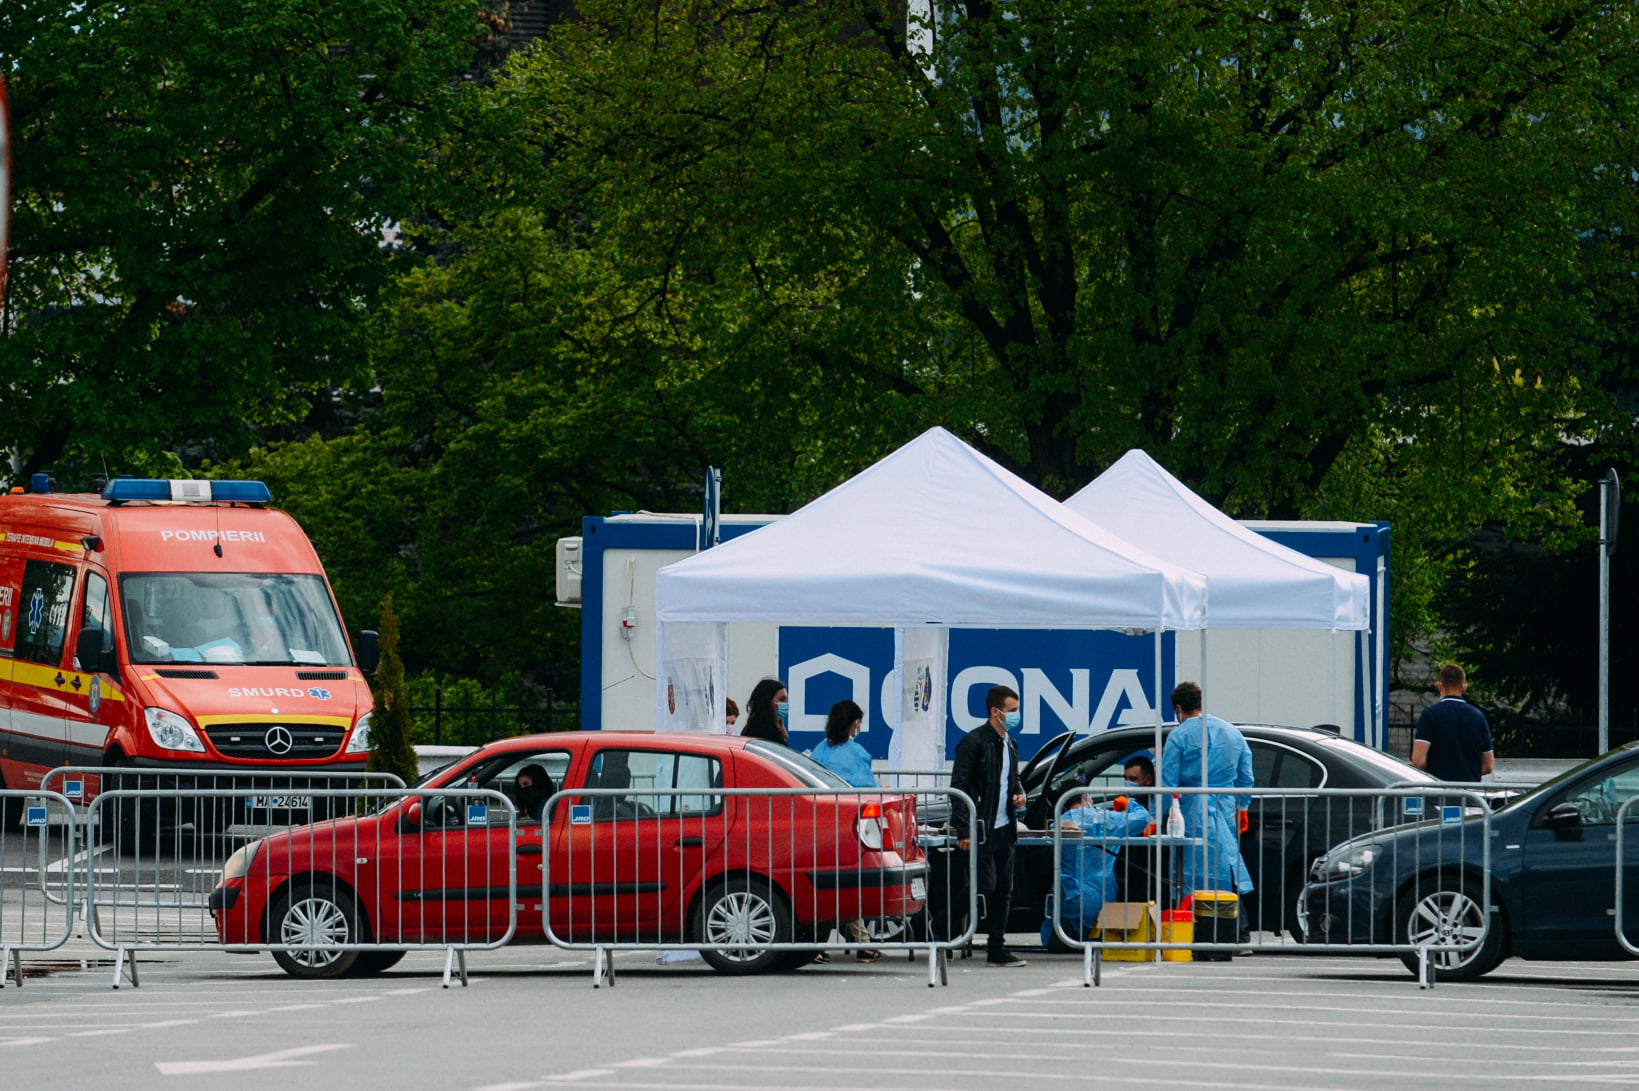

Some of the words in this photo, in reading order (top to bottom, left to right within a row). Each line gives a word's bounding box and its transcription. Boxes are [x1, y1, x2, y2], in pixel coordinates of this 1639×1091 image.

[161, 530, 266, 543] POMPIERII
[228, 687, 305, 698] SMURD
[881, 665, 1164, 735] ONA
[278, 796, 310, 808] 24614
